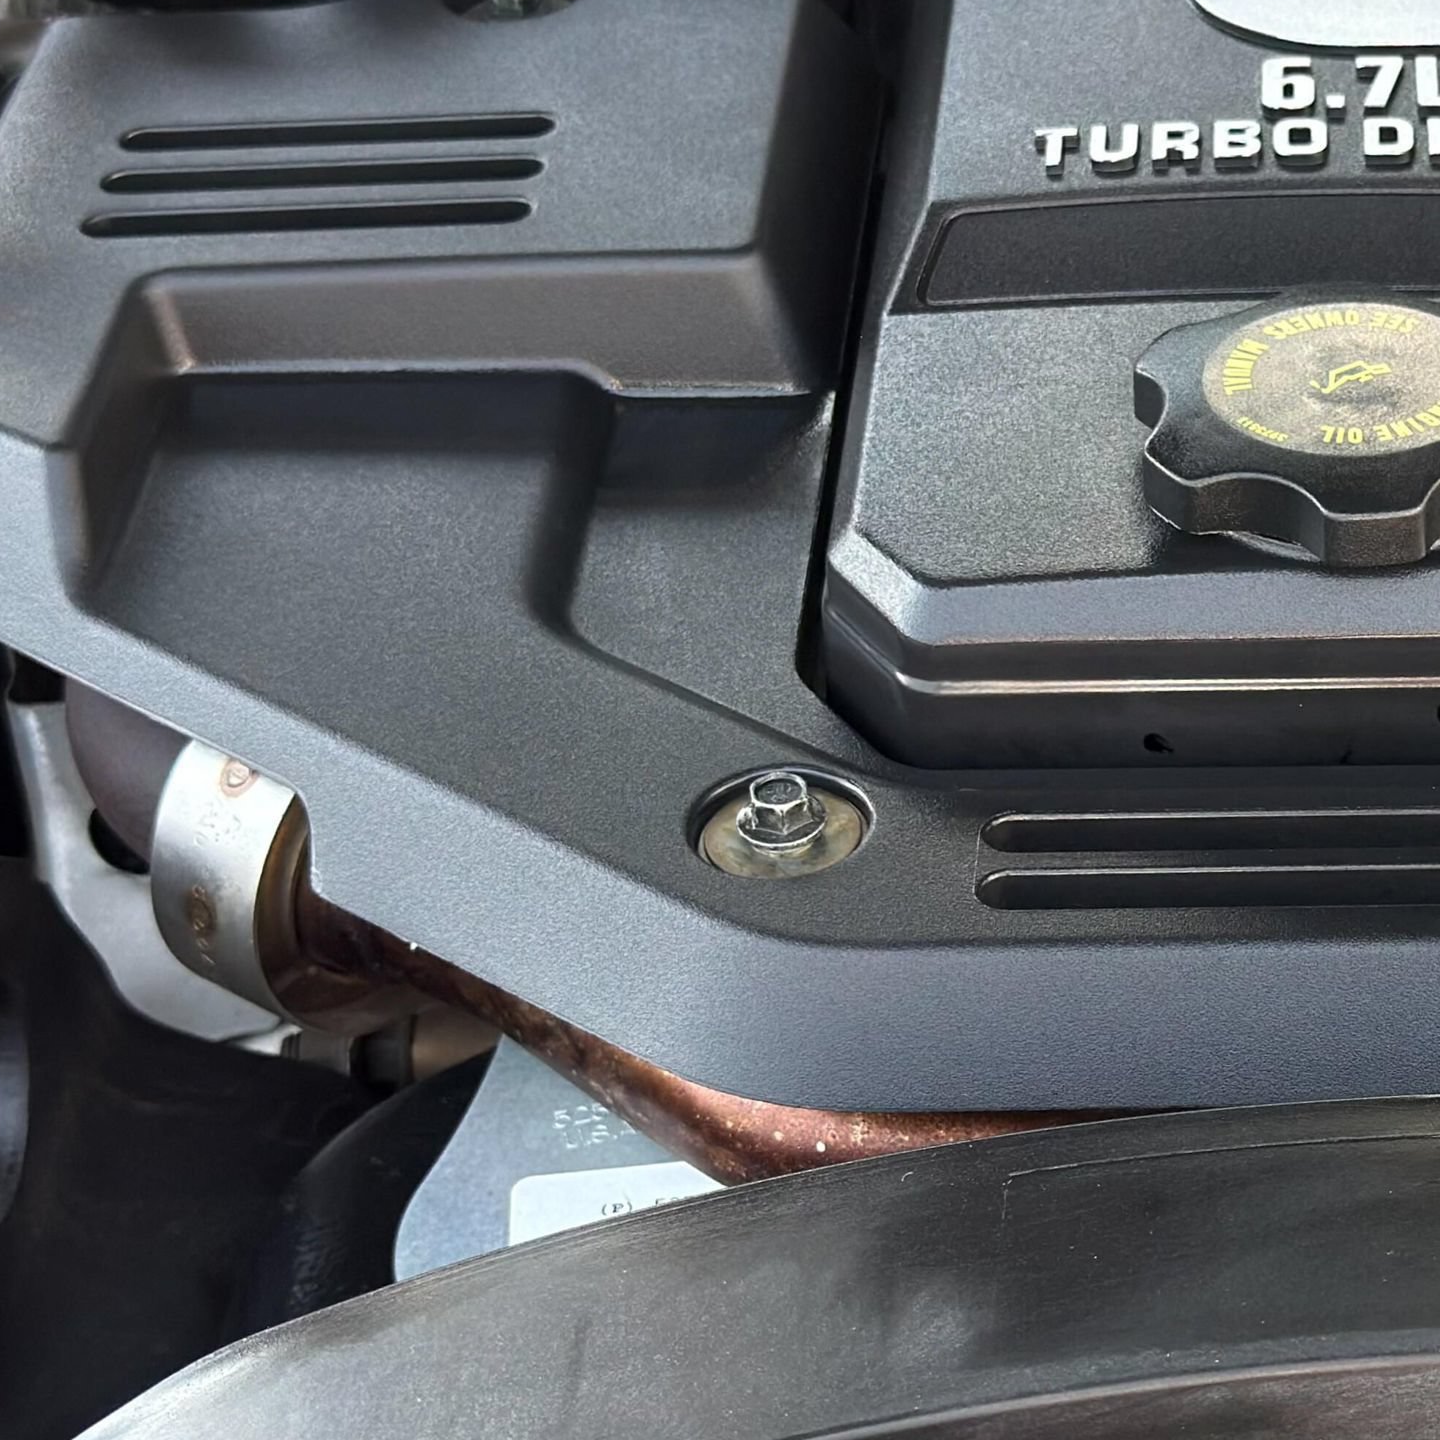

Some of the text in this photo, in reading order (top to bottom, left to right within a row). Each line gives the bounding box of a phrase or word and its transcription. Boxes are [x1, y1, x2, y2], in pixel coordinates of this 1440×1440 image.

[1033, 117, 1329, 176] TURBO
[1263, 310, 1360, 341] OWNERS
[1368, 310, 1421, 335] SEE
[1321, 424, 1363, 445] OIL
